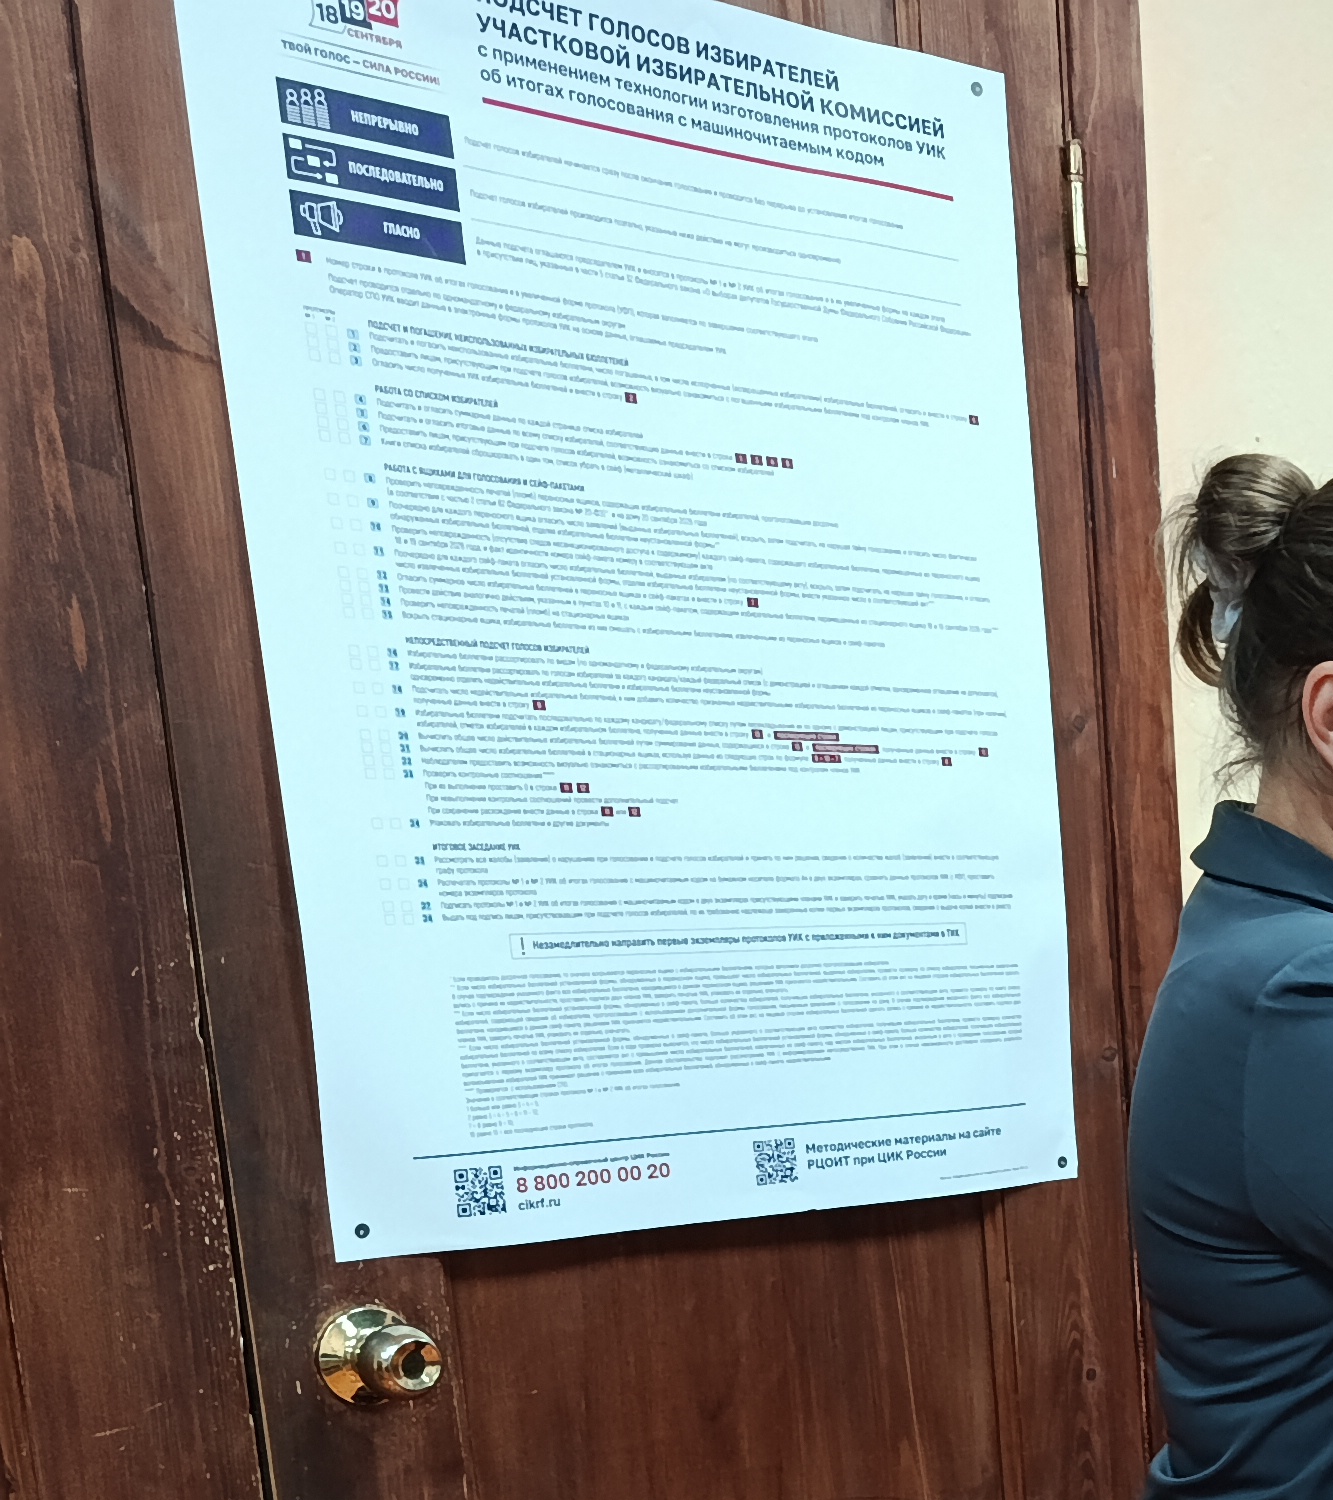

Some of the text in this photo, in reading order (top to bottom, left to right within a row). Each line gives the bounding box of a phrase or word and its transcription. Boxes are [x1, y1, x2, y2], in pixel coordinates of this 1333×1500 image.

[316, 3, 338, 25] 18
[341, 0, 365, 21] 19
[369, 0, 396, 19] 20
[347, 28, 402, 49] СЕНТЯБРЯ
[476, 0, 839, 91] ДСЧЕТ ГОЛОСОВ ИЗБИРАТЕЛЕЙ
[281, 39, 312, 56] ТВОЙ
[314, 47, 351, 65] ГОЛОС
[362, 59, 392, 75] СИЛА
[476, 12, 944, 139] УЧАСТКОВОЙ ИЗБИРАТЕЛЬНОЙ КОМИССИЕЙ
[477, 44, 945, 160] с применением технологии изготовления протоколов УИК
[350, 110, 419, 137] НЕПРЕРЫВНО
[480, 68, 884, 166] об итогах голосования с машиночитаемым кодом
[348, 160, 444, 192] ПОСЛЕДОВАТЕЛЬНО
[383, 221, 420, 240] ГЛАСНО
[805, 1126, 1001, 1154] Методические материалы на сайте
[807, 1148, 946, 1169] РЦОИТ при ЦИК России
[516, 1162, 670, 1193] 8 800 200 00 20
[518, 1197, 560, 1210] cikrf.ru
